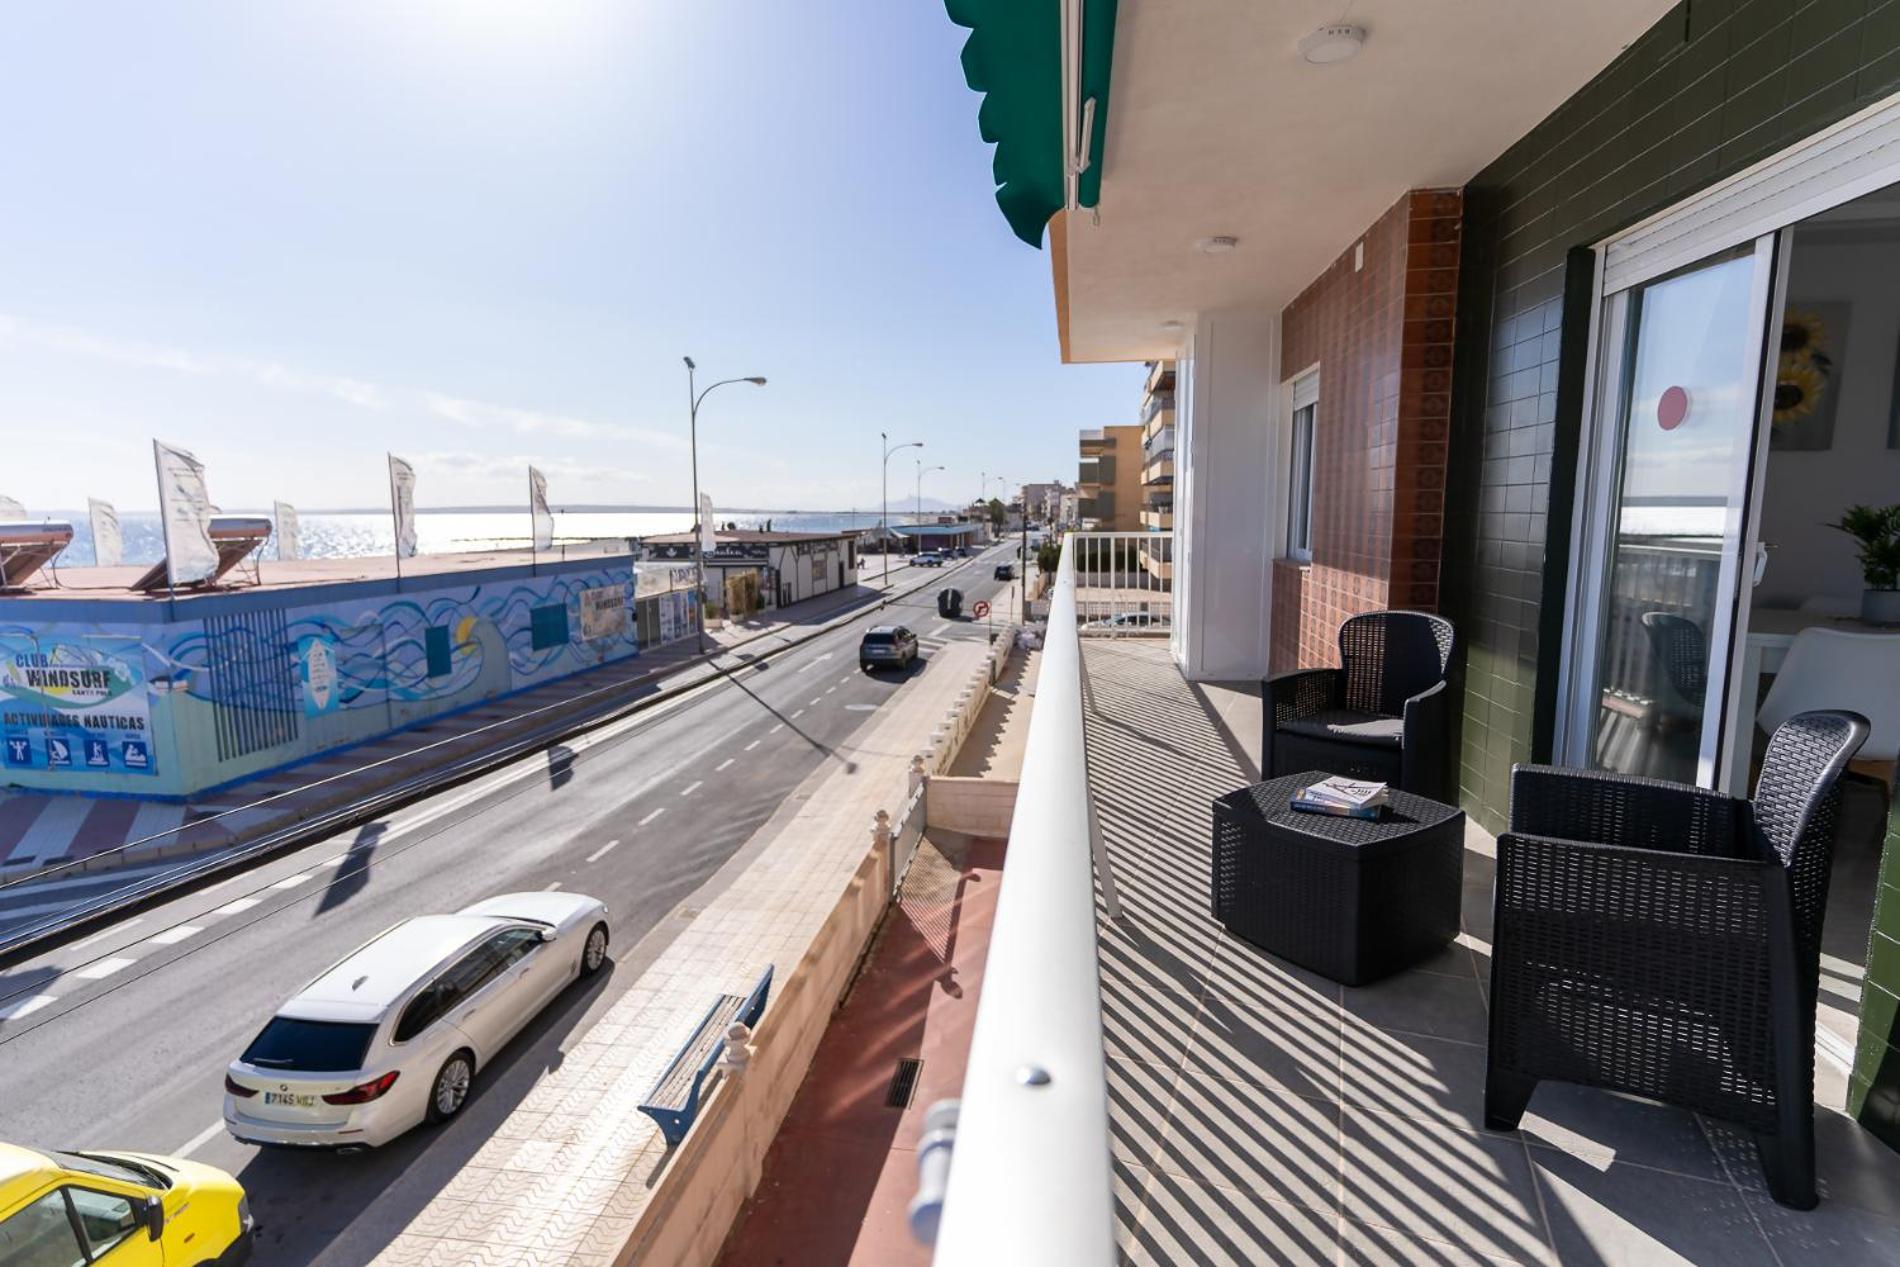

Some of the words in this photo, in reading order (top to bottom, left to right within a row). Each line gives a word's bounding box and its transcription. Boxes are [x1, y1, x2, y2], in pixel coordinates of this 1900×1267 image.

[15, 653, 49, 668] CLUB
[26, 669, 111, 688] WINDSURF
[84, 714, 145, 730] NAUTICAS
